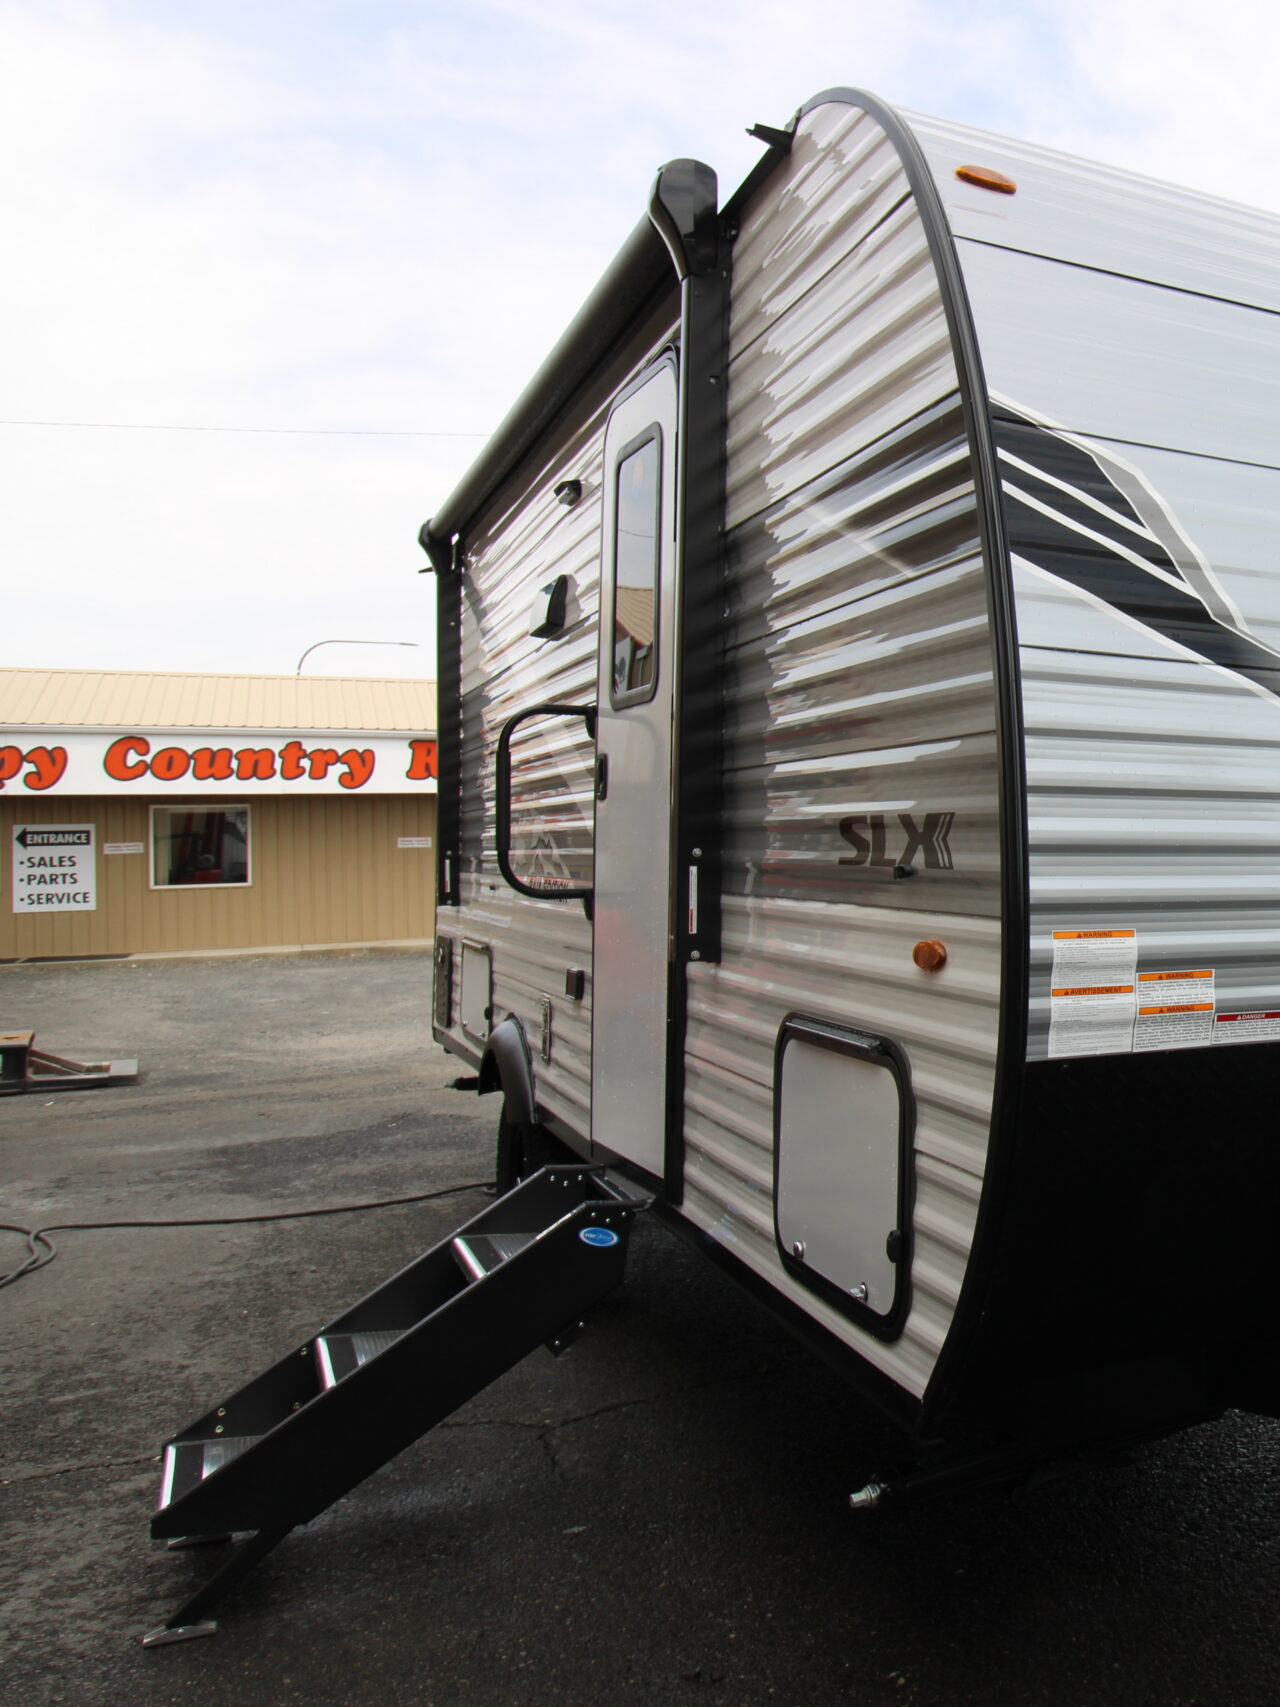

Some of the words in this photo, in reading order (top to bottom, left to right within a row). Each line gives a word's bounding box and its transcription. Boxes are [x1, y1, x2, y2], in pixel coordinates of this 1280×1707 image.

[103, 736, 375, 789] Country
[26, 832, 88, 844] ENTRANCE
[838, 812, 956, 870] SLX
[27, 856, 77, 868] SALES
[27, 873, 78, 885] PARTS
[27, 892, 91, 905] SERVICE
[1165, 971, 1195, 980] WARNING
[1166, 1005, 1195, 1014] WARNING
